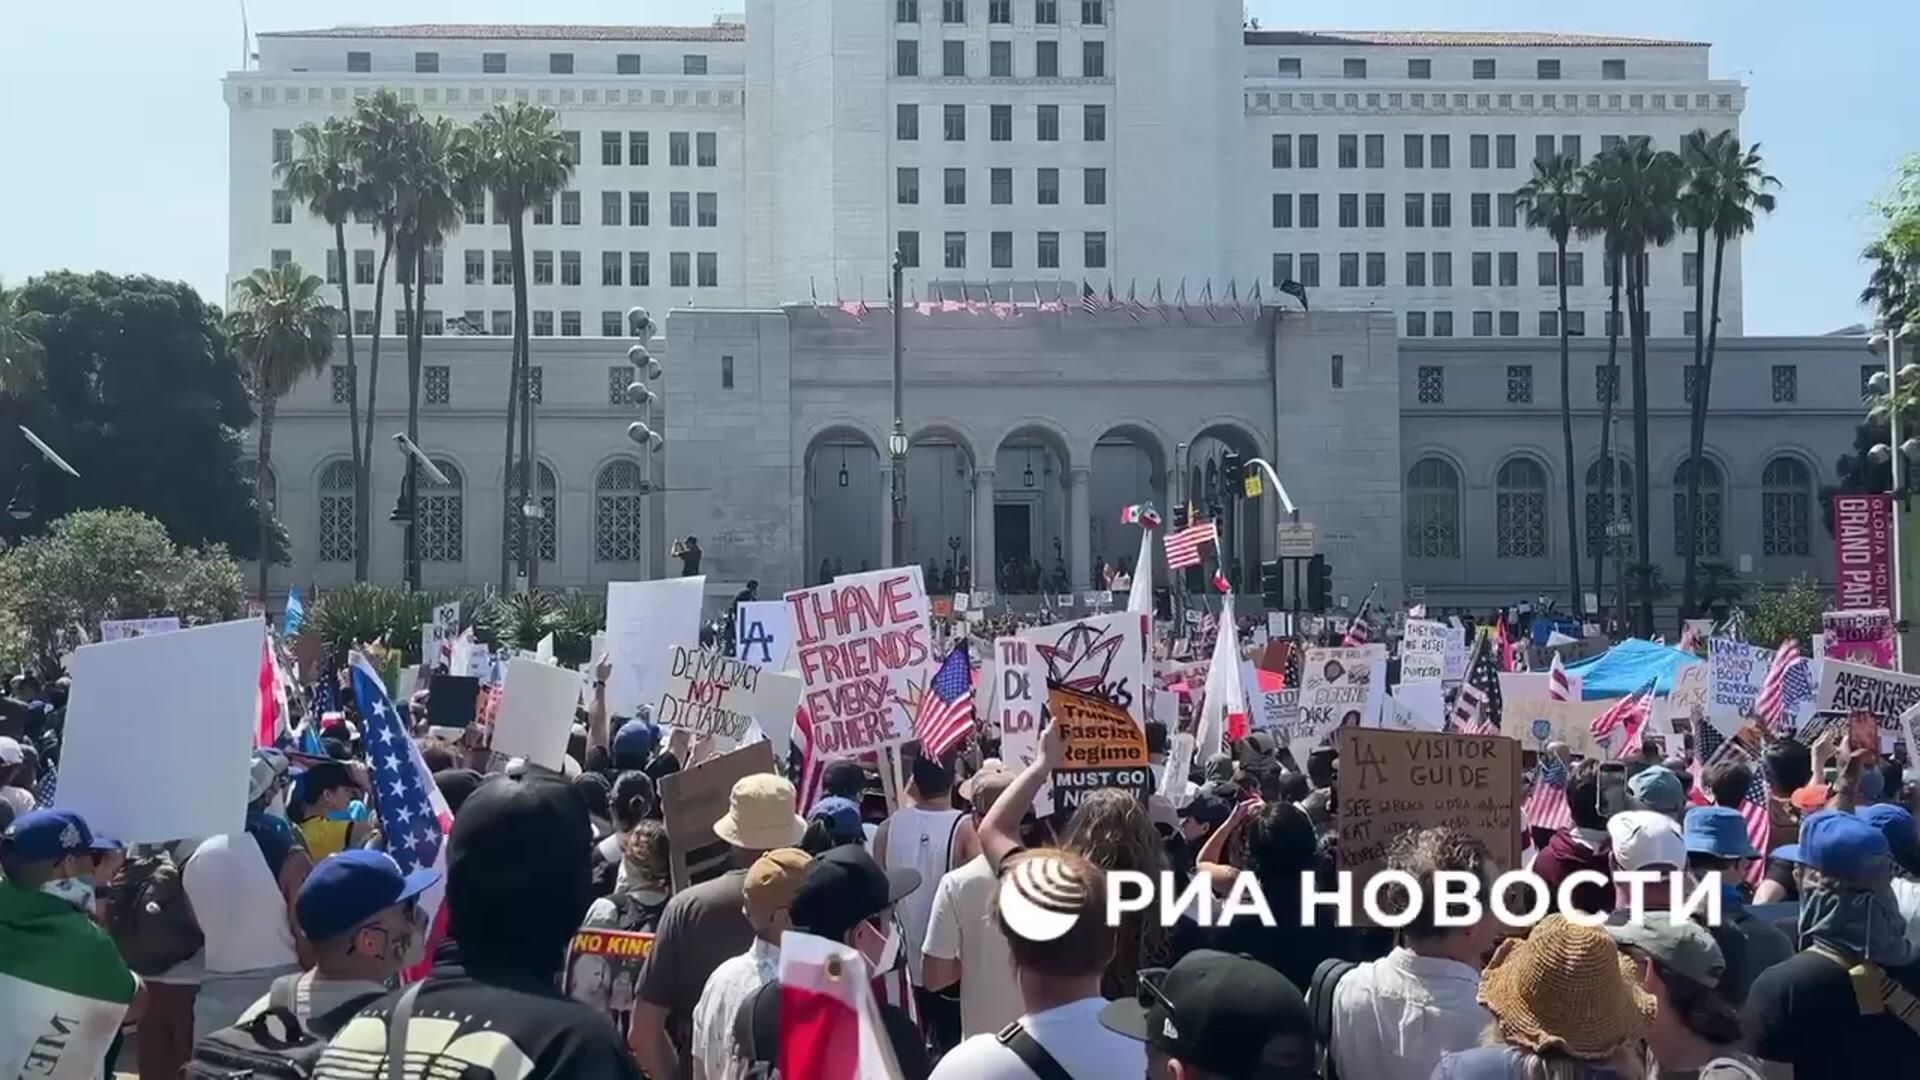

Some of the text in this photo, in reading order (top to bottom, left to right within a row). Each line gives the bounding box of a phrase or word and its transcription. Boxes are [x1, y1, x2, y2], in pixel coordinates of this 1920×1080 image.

[1839, 499, 1871, 564] GRAND
[1871, 499, 1885, 555] GLORIA
[787, 576, 919, 647] I HAVE
[739, 607, 774, 662] LA
[798, 624, 929, 686] FRIENDS
[672, 646, 762, 694] DEMOCRACY
[1717, 667, 1751, 683] BODY
[687, 680, 730, 708] NOT
[806, 676, 897, 725] EVERY-
[815, 707, 901, 754] WHERE
[1059, 723, 1139, 741] Fascist
[1406, 739, 1498, 760] VISITOR
[1056, 770, 1145, 786] MUST GO
[1411, 766, 1490, 788] GUIDE
[1343, 799, 1375, 817] SEE
[1343, 819, 1372, 840] EAT
[573, 933, 602, 952] NO
